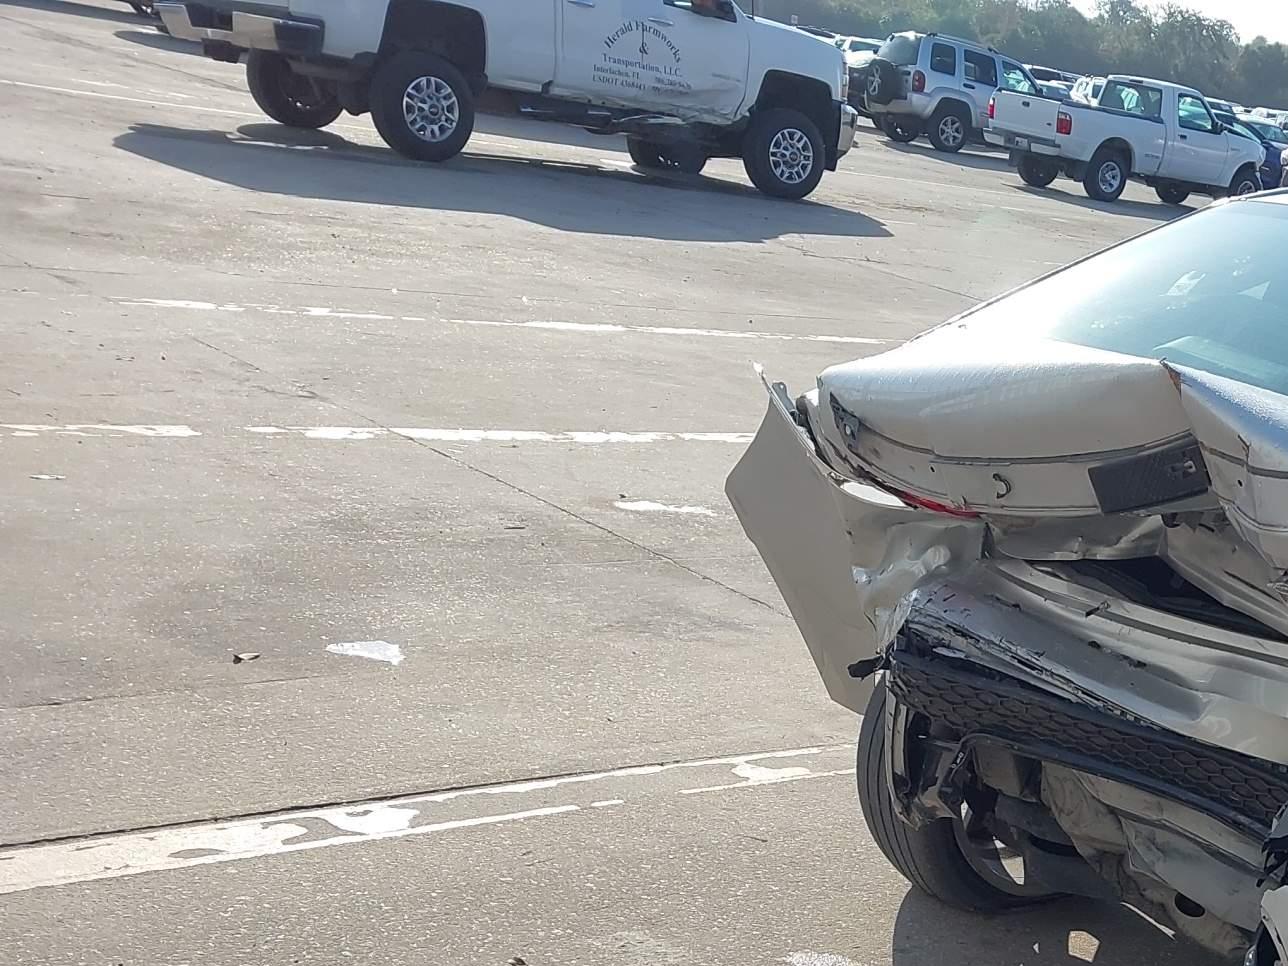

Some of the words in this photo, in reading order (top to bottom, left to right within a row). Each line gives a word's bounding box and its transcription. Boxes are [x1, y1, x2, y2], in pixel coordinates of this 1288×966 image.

[604, 21, 633, 49] Herald
[635, 20, 681, 63] Farmworks
[602, 53, 662, 74] Transportation,
